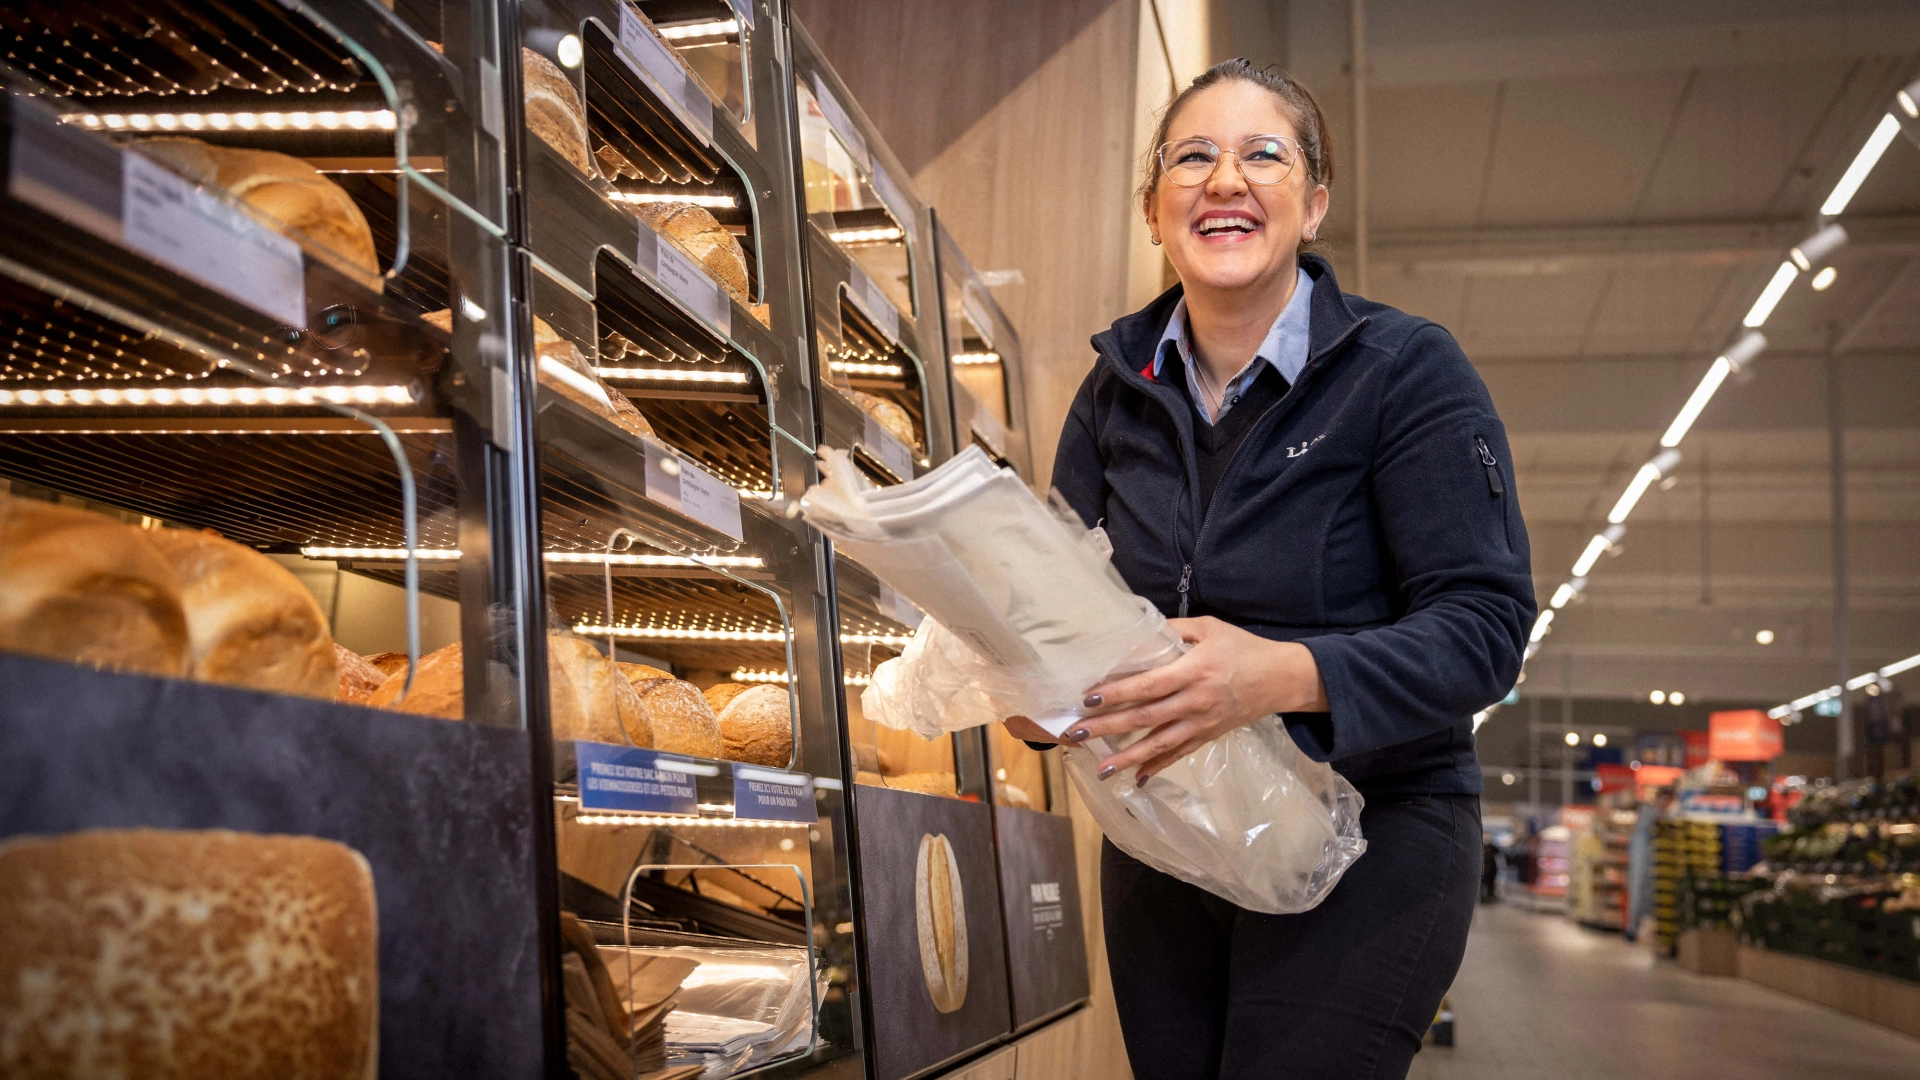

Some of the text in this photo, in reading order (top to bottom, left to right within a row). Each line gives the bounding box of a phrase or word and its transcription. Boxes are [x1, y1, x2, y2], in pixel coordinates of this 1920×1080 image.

[771, 784, 783, 795] VOTRE
[758, 795, 770, 805] POUR
[770, 796, 777, 806] UN
[776, 796, 787, 807] PAIN
